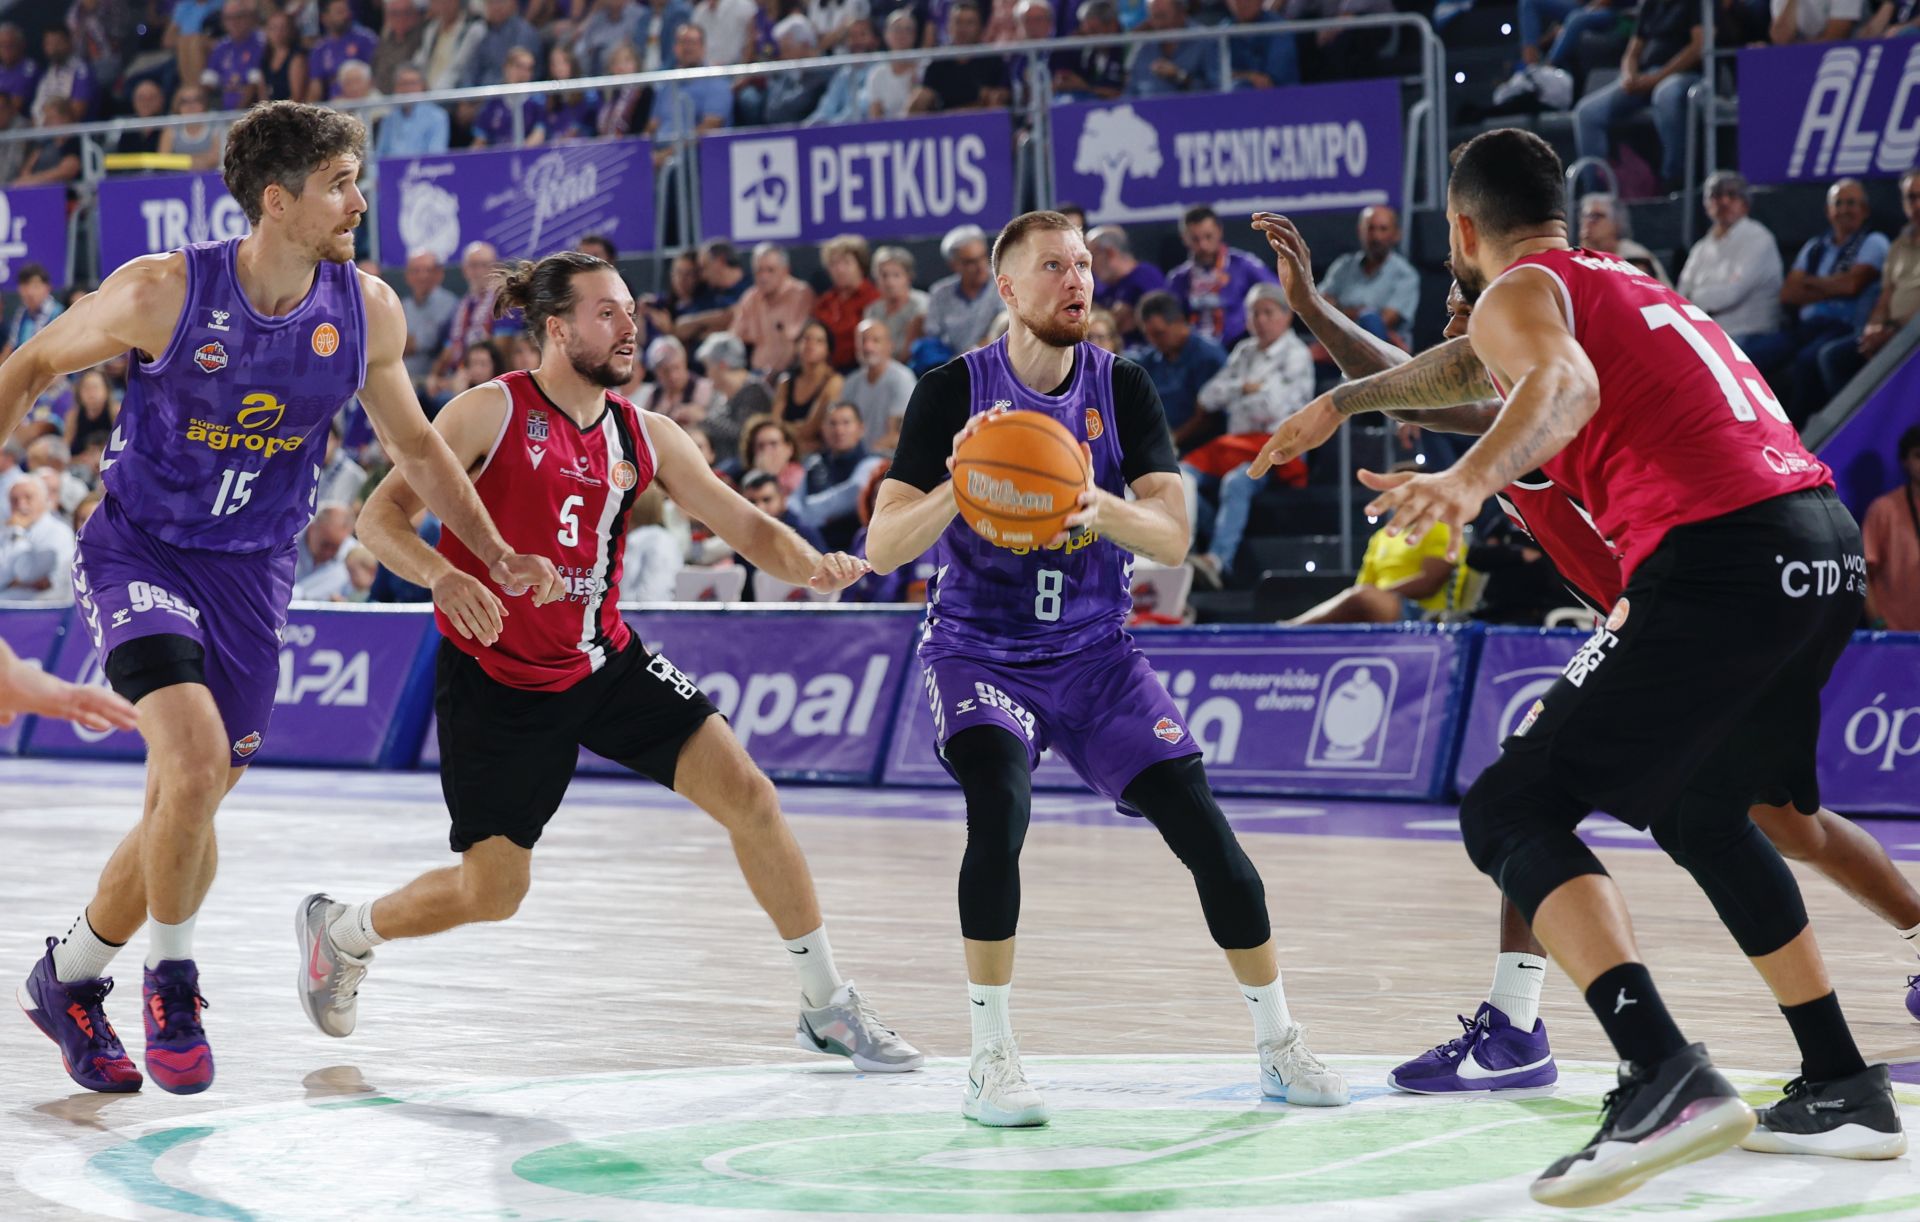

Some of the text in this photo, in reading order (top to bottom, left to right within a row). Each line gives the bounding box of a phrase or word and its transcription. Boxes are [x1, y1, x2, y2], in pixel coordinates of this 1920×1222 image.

[1174, 121, 1367, 188] TECNICAMPO
[809, 134, 987, 224] PETKUS
[189, 417, 231, 432] súper
[210, 468, 261, 517] 15
[968, 470, 1054, 512] Wilson
[557, 494, 584, 548] 5
[558, 565, 594, 577] RUPO
[1781, 560, 1841, 598] CTD
[1034, 568, 1063, 622] 8
[694, 654, 890, 748] opal
[1209, 668, 1320, 690] autoservicios
[1255, 690, 1315, 711] ahorro
